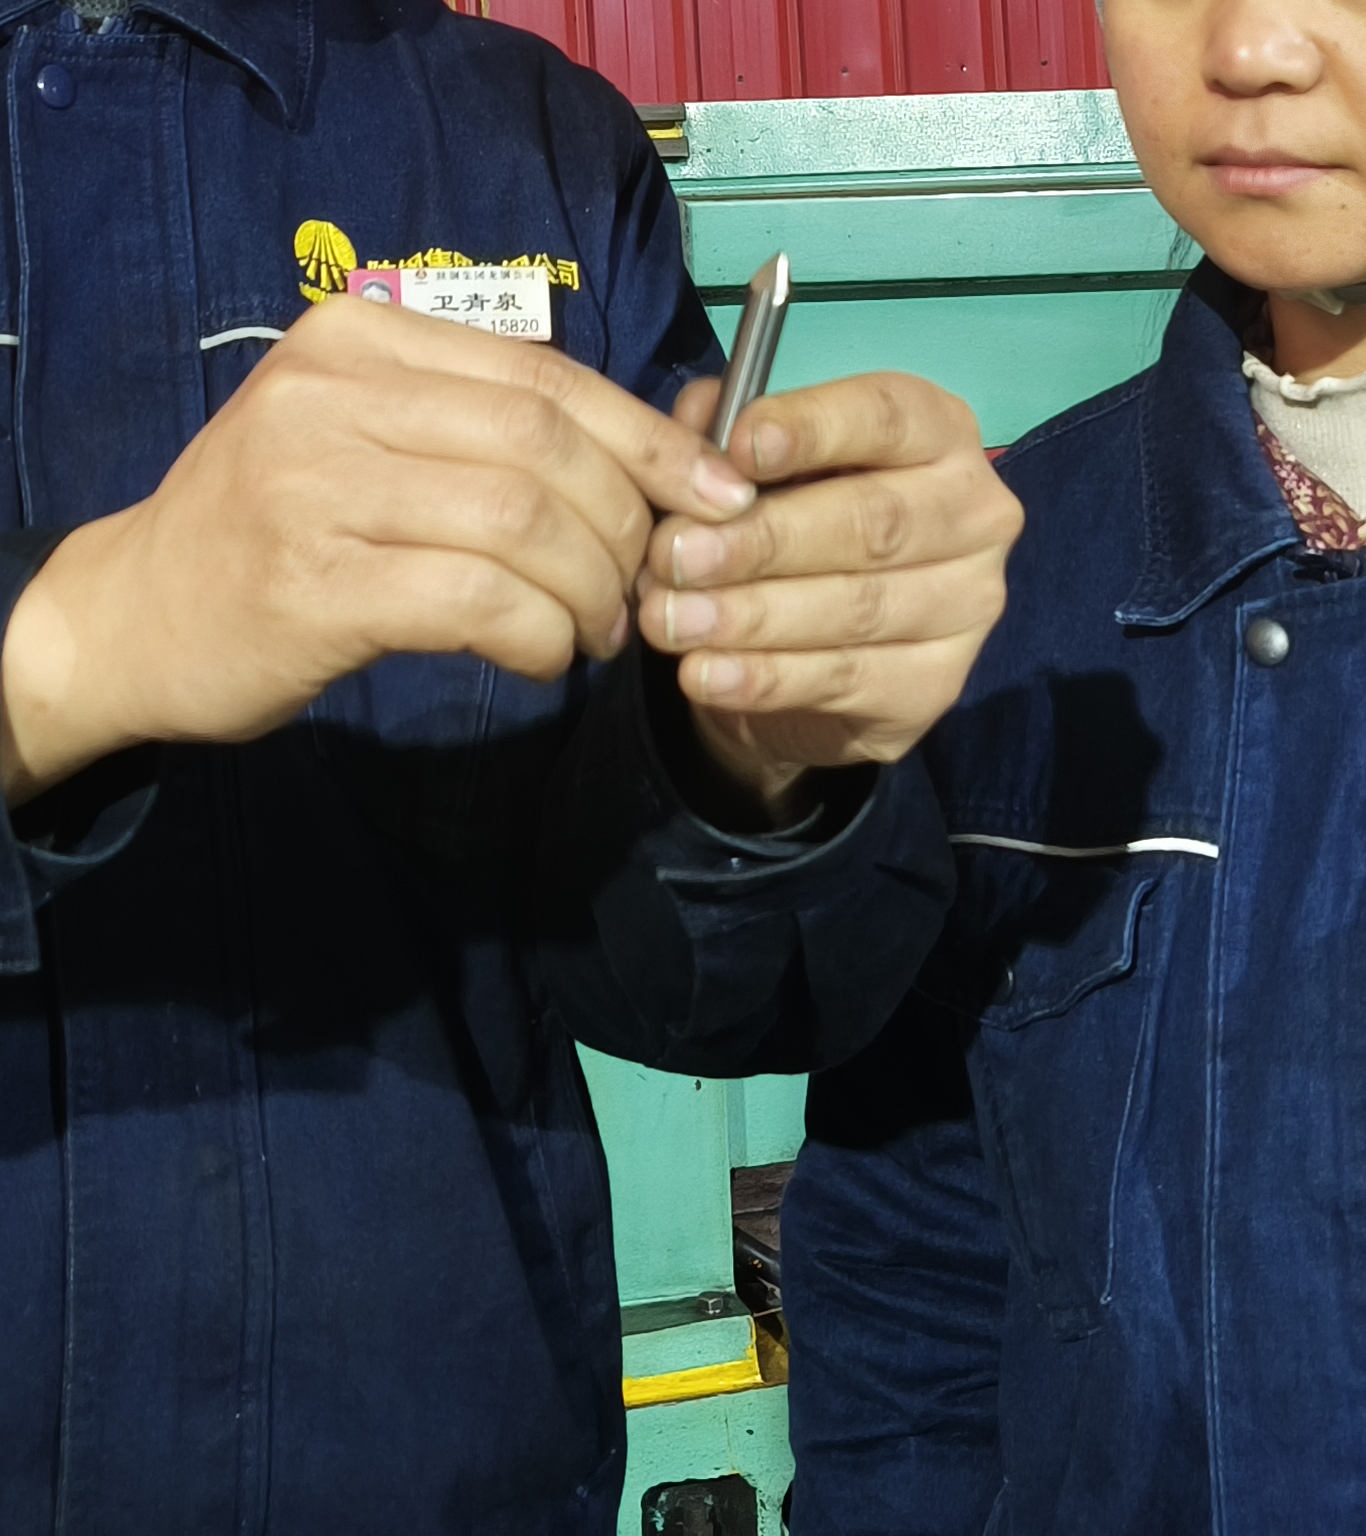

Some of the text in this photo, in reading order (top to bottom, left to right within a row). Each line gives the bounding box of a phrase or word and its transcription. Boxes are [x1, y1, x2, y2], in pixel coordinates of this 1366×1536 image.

[430, 292, 523, 312] 卫青泉
[491, 318, 539, 334] 15820
